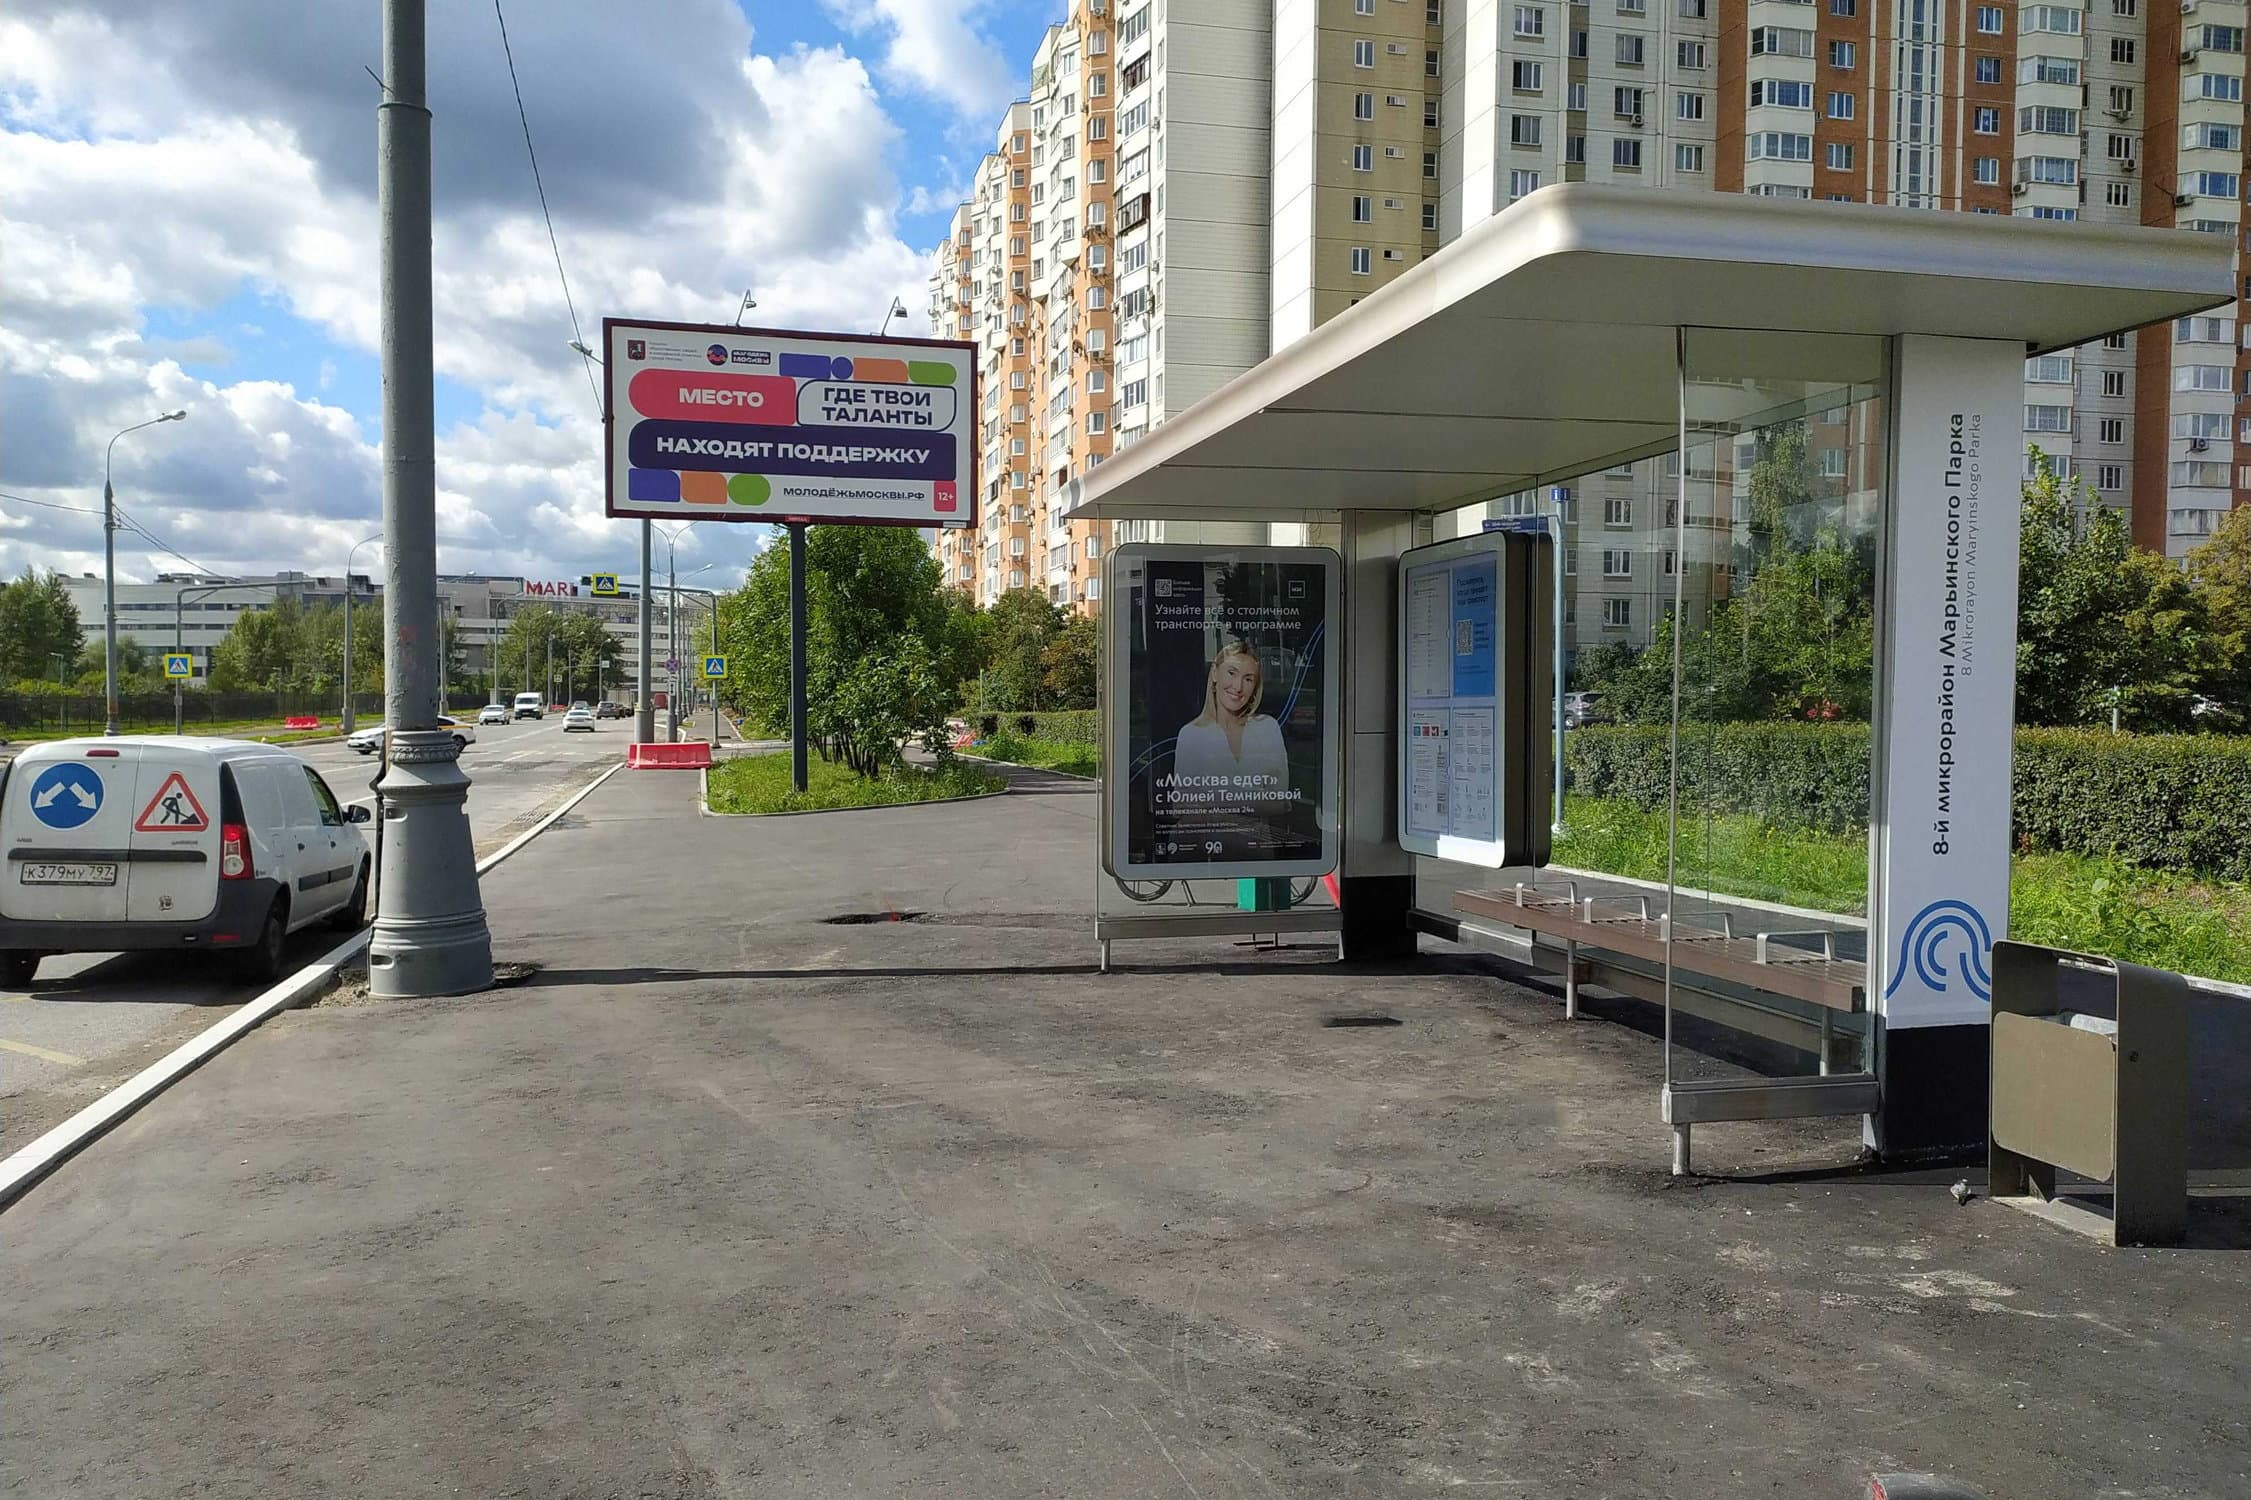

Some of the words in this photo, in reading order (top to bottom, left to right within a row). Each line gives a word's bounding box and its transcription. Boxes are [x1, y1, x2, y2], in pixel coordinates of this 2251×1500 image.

[679, 387, 764, 408] МЕСТО
[824, 387, 865, 405] ГДЕ
[870, 389, 931, 407] ТВОИ
[822, 406, 933, 426] ТАЛАНТЫ
[1969, 414, 1981, 458] Parka
[657, 436, 774, 459] НАХОДЯТ
[778, 443, 930, 464] ПОДДЕРЖКУ
[1945, 413, 1966, 487] Парка
[783, 487, 925, 500] МОЛОДЁЖЬМОСКВЫ.РФ
[938, 492, 954, 501] 12+
[1965, 463, 1981, 566] Maryinskogo
[1939, 495, 1961, 658] Марьинского
[1155, 604, 1200, 615] Узнайте
[1205, 605, 1224, 615] всё
[1237, 607, 1300, 615] столичном
[1962, 571, 1977, 662] Mikrorayon
[1155, 620, 1223, 631] транспорте
[1226, 621, 1232, 629] в
[1235, 620, 1301, 631] программе
[1961, 666, 1972, 676] 8
[1937, 664, 1956, 813] микрорайон
[1156, 773, 1228, 787] «Москва
[1233, 774, 1278, 787] едет»
[1156, 793, 1163, 802] с
[1167, 789, 1215, 802] Юлией
[1219, 788, 1301, 802] Темниковой
[1933, 820, 1949, 855] 8-й
[89, 865, 111, 876] 797
